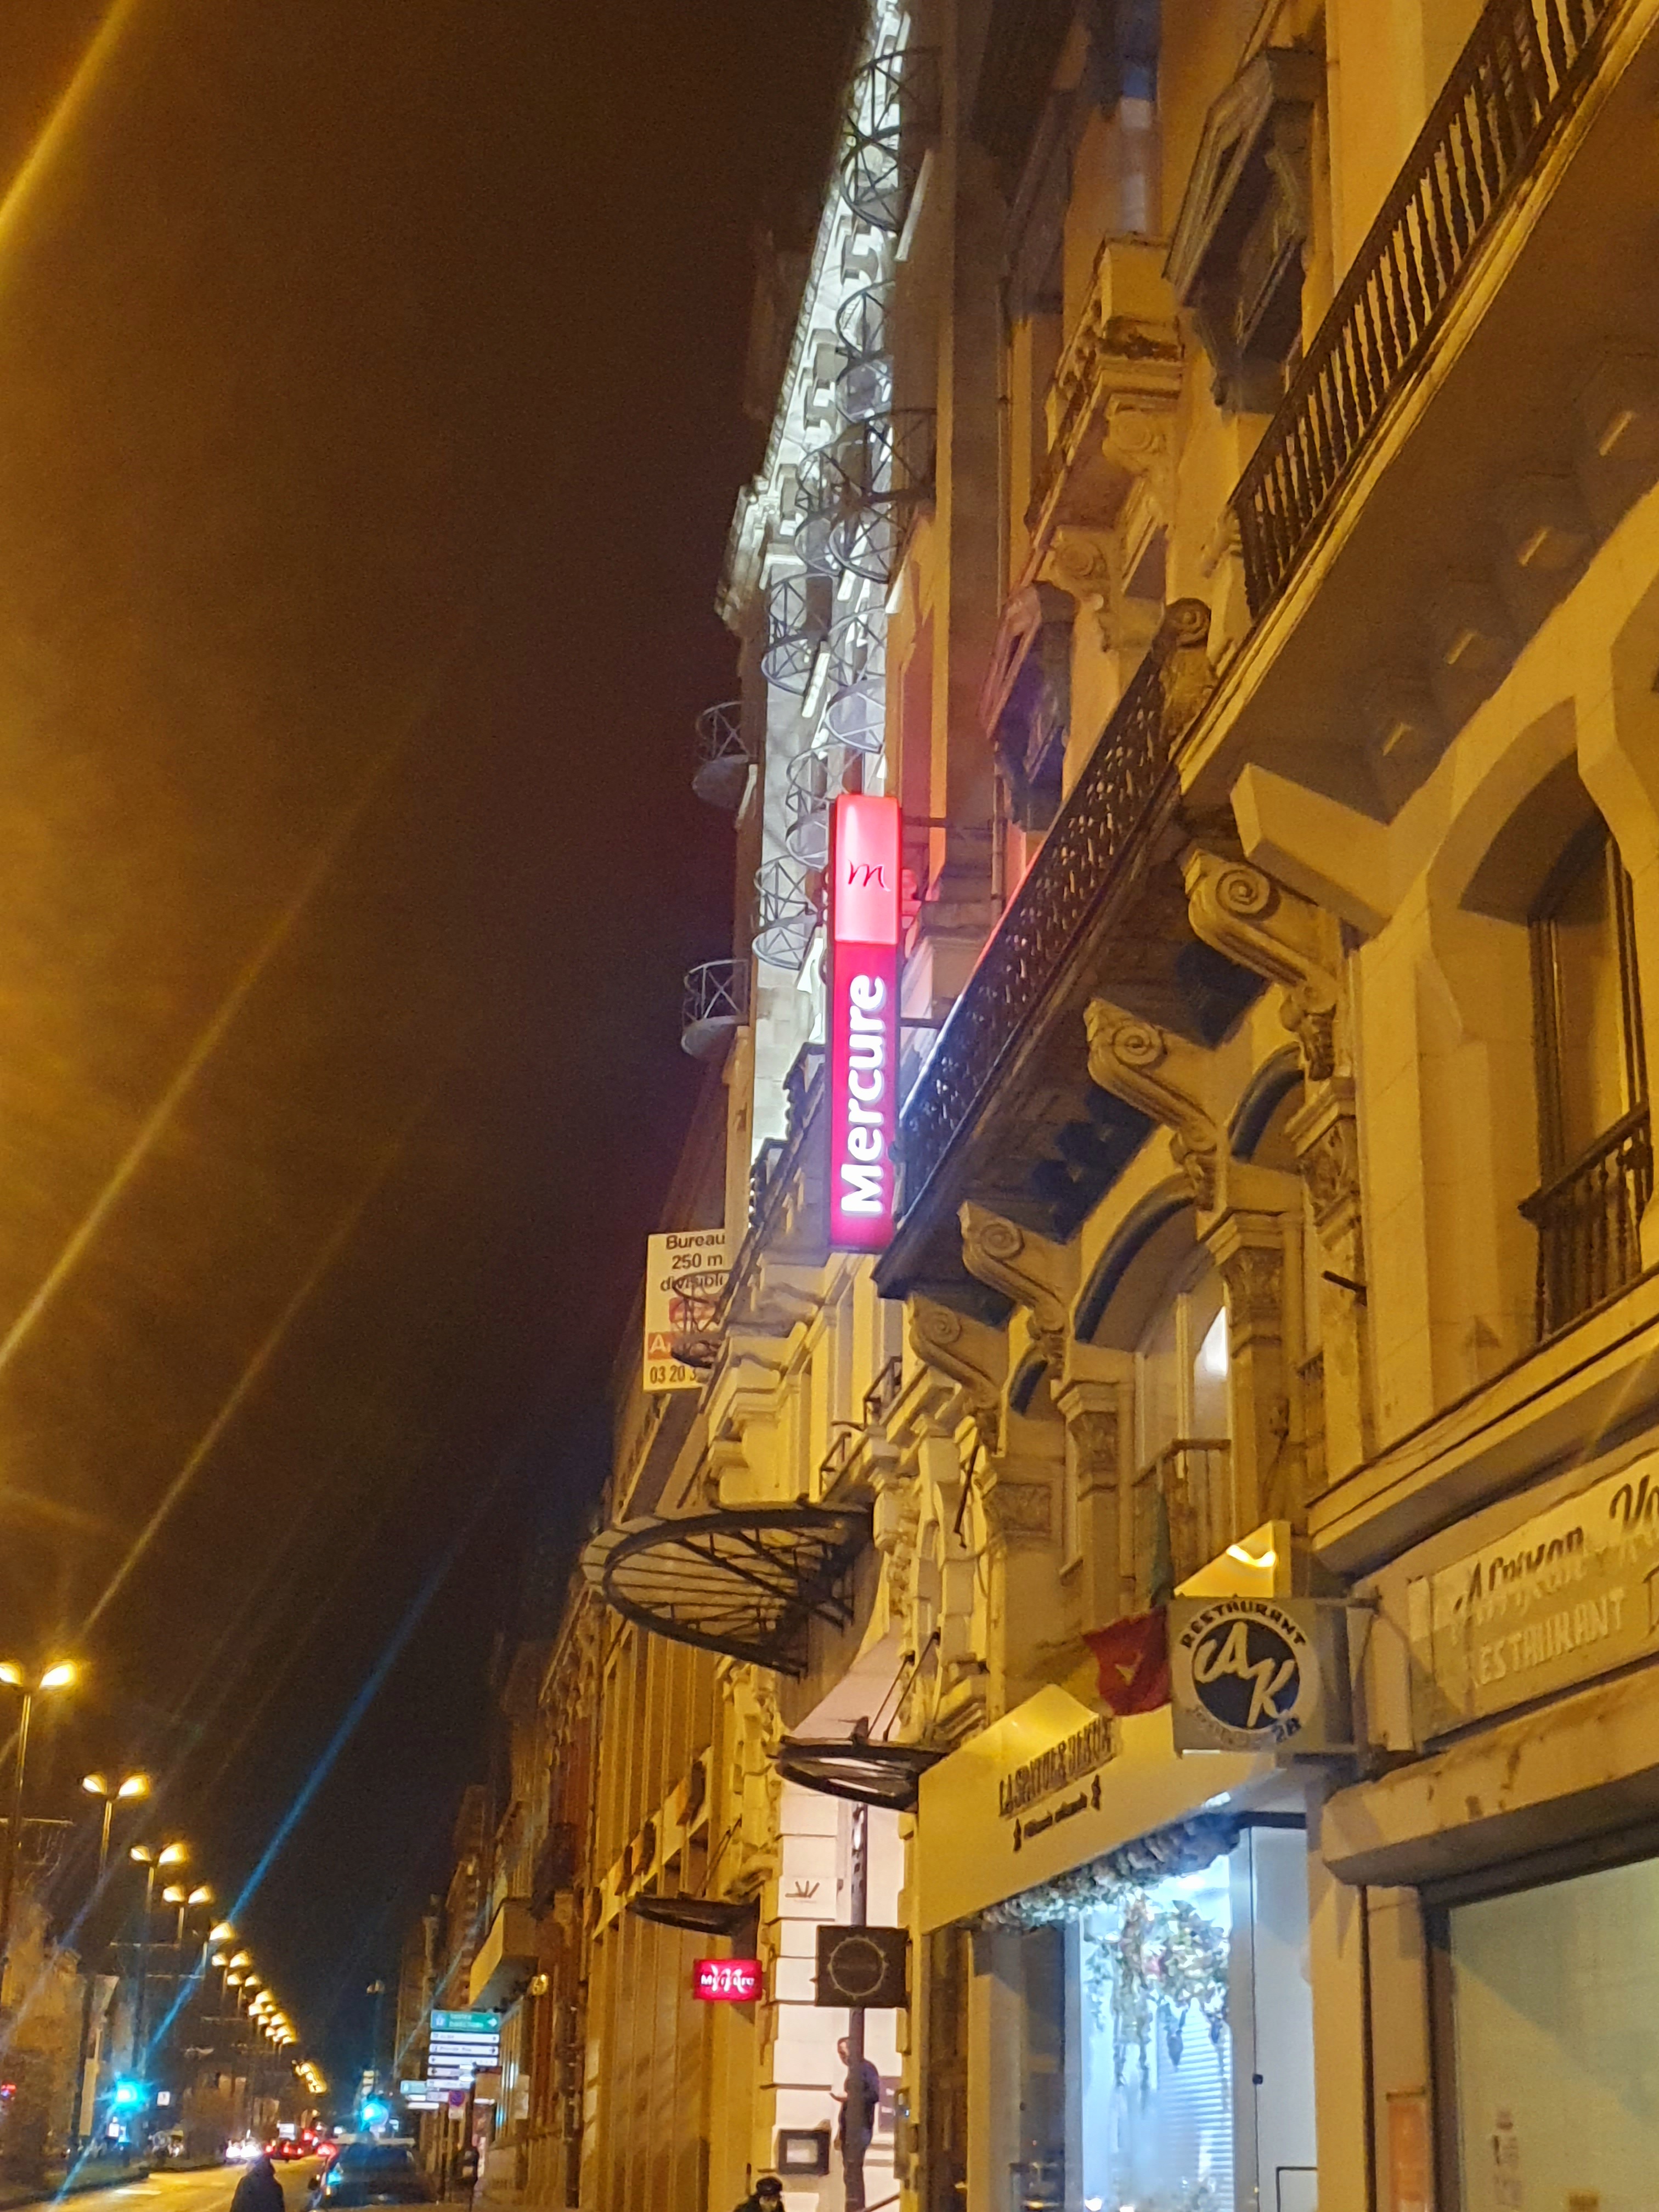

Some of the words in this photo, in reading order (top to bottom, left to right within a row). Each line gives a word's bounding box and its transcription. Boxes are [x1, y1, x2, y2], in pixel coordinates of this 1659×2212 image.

[841, 974, 885, 1216] Mercure
[672, 1253, 702, 1269] 250
[650, 1365, 665, 1384] 03
[669, 1364, 686, 1382] 20
[1180, 1600, 1306, 1649] RESTAURANT
